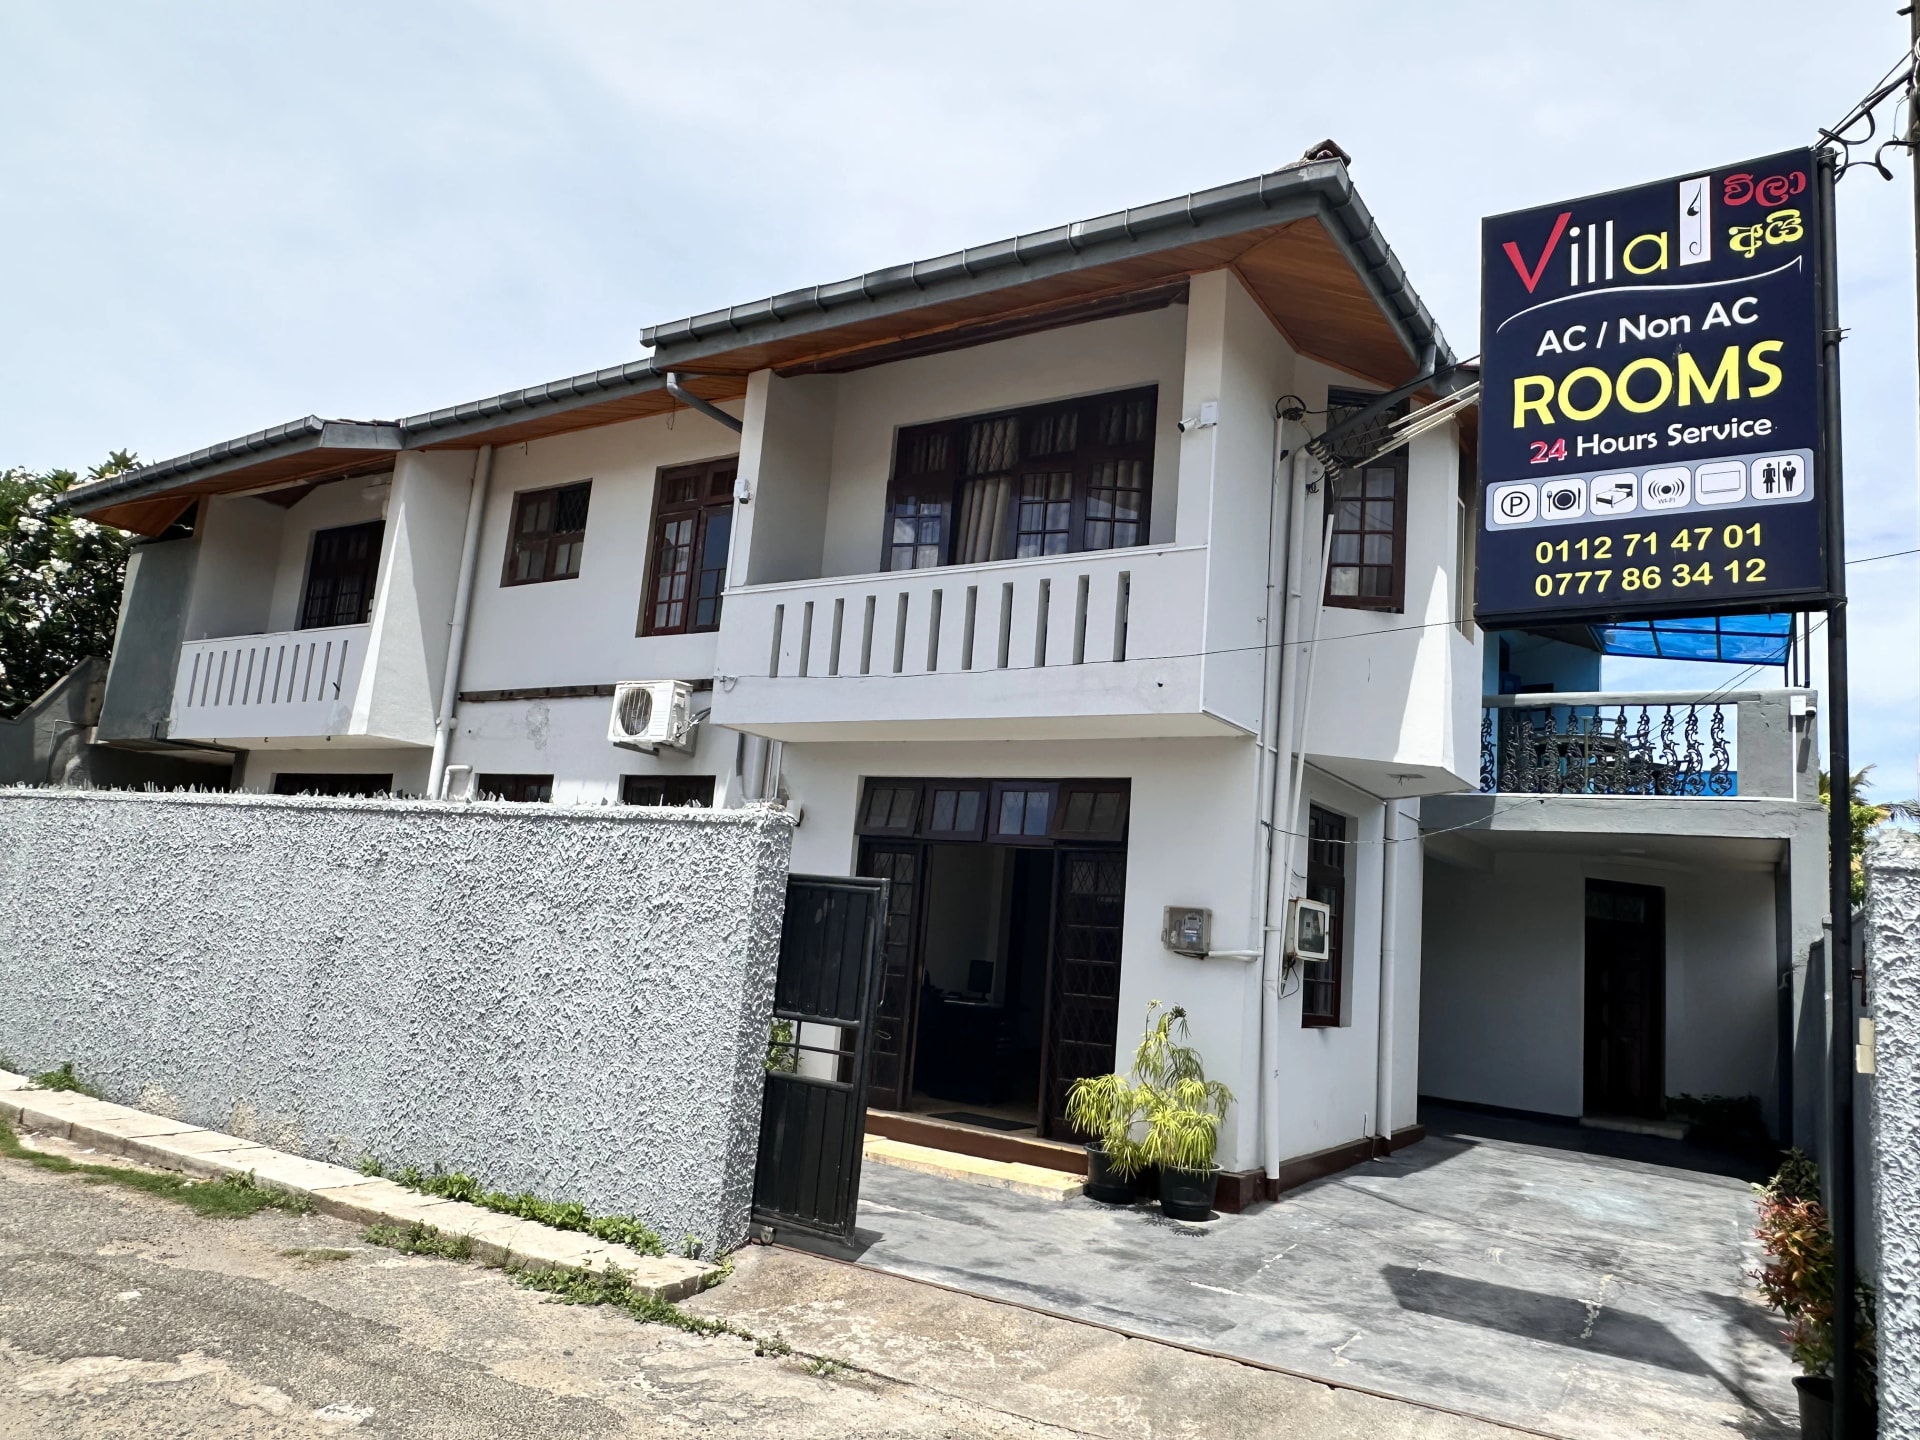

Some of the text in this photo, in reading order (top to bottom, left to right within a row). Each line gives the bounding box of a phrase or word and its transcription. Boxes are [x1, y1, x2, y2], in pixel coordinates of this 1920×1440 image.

[1502, 212, 1668, 294] Villa
[1535, 324, 1588, 357] AC
[1618, 313, 1691, 344] Non
[1701, 296, 1759, 331] AC
[1513, 340, 1784, 429] ROOMS
[1529, 417, 1772, 464] 24 Hours Service
[1535, 522, 1762, 564] 0112 71 47 01
[1534, 557, 1767, 597] 0777 86 34 12
